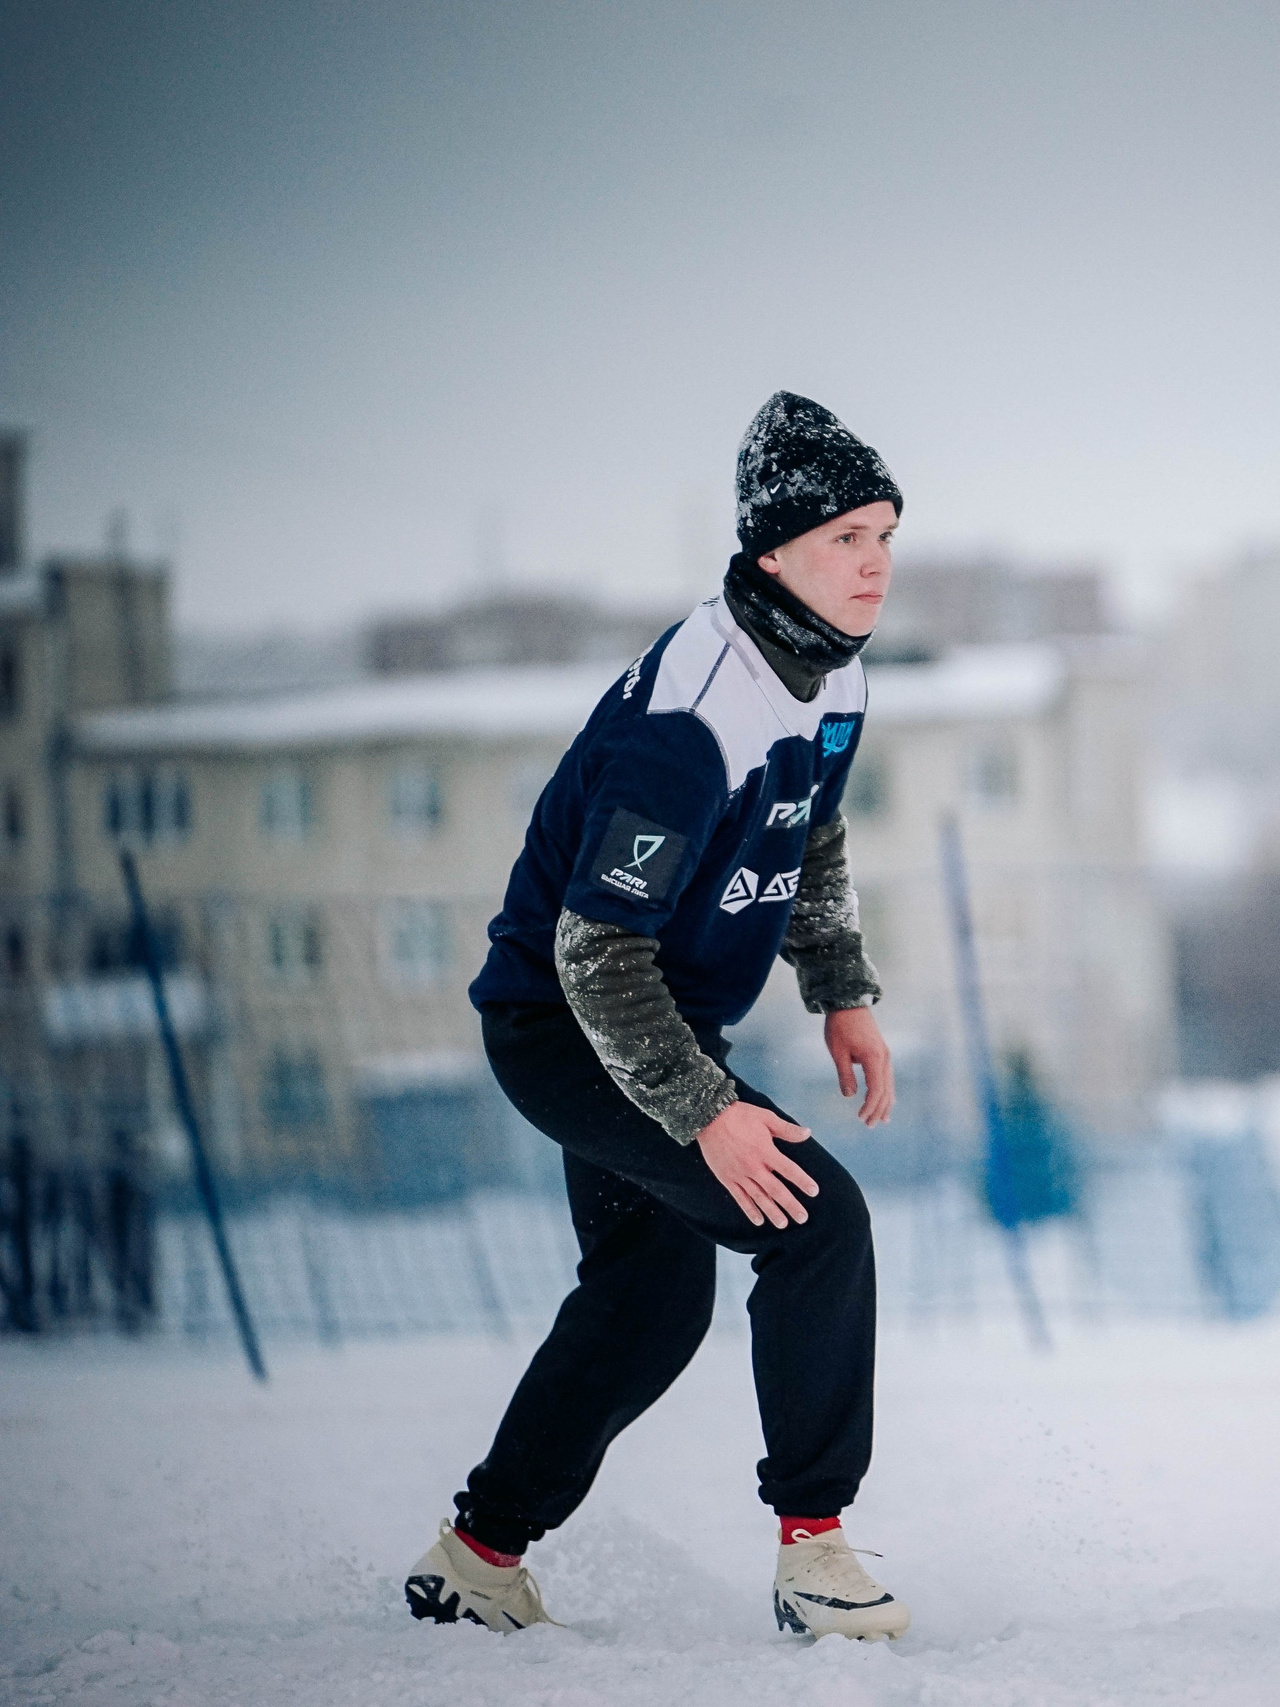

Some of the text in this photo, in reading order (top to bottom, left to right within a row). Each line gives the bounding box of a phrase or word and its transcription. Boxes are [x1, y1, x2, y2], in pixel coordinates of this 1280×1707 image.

[601, 873, 649, 899] ВЫСШАЯ ЛИГА
[610, 867, 647, 890] PARI
